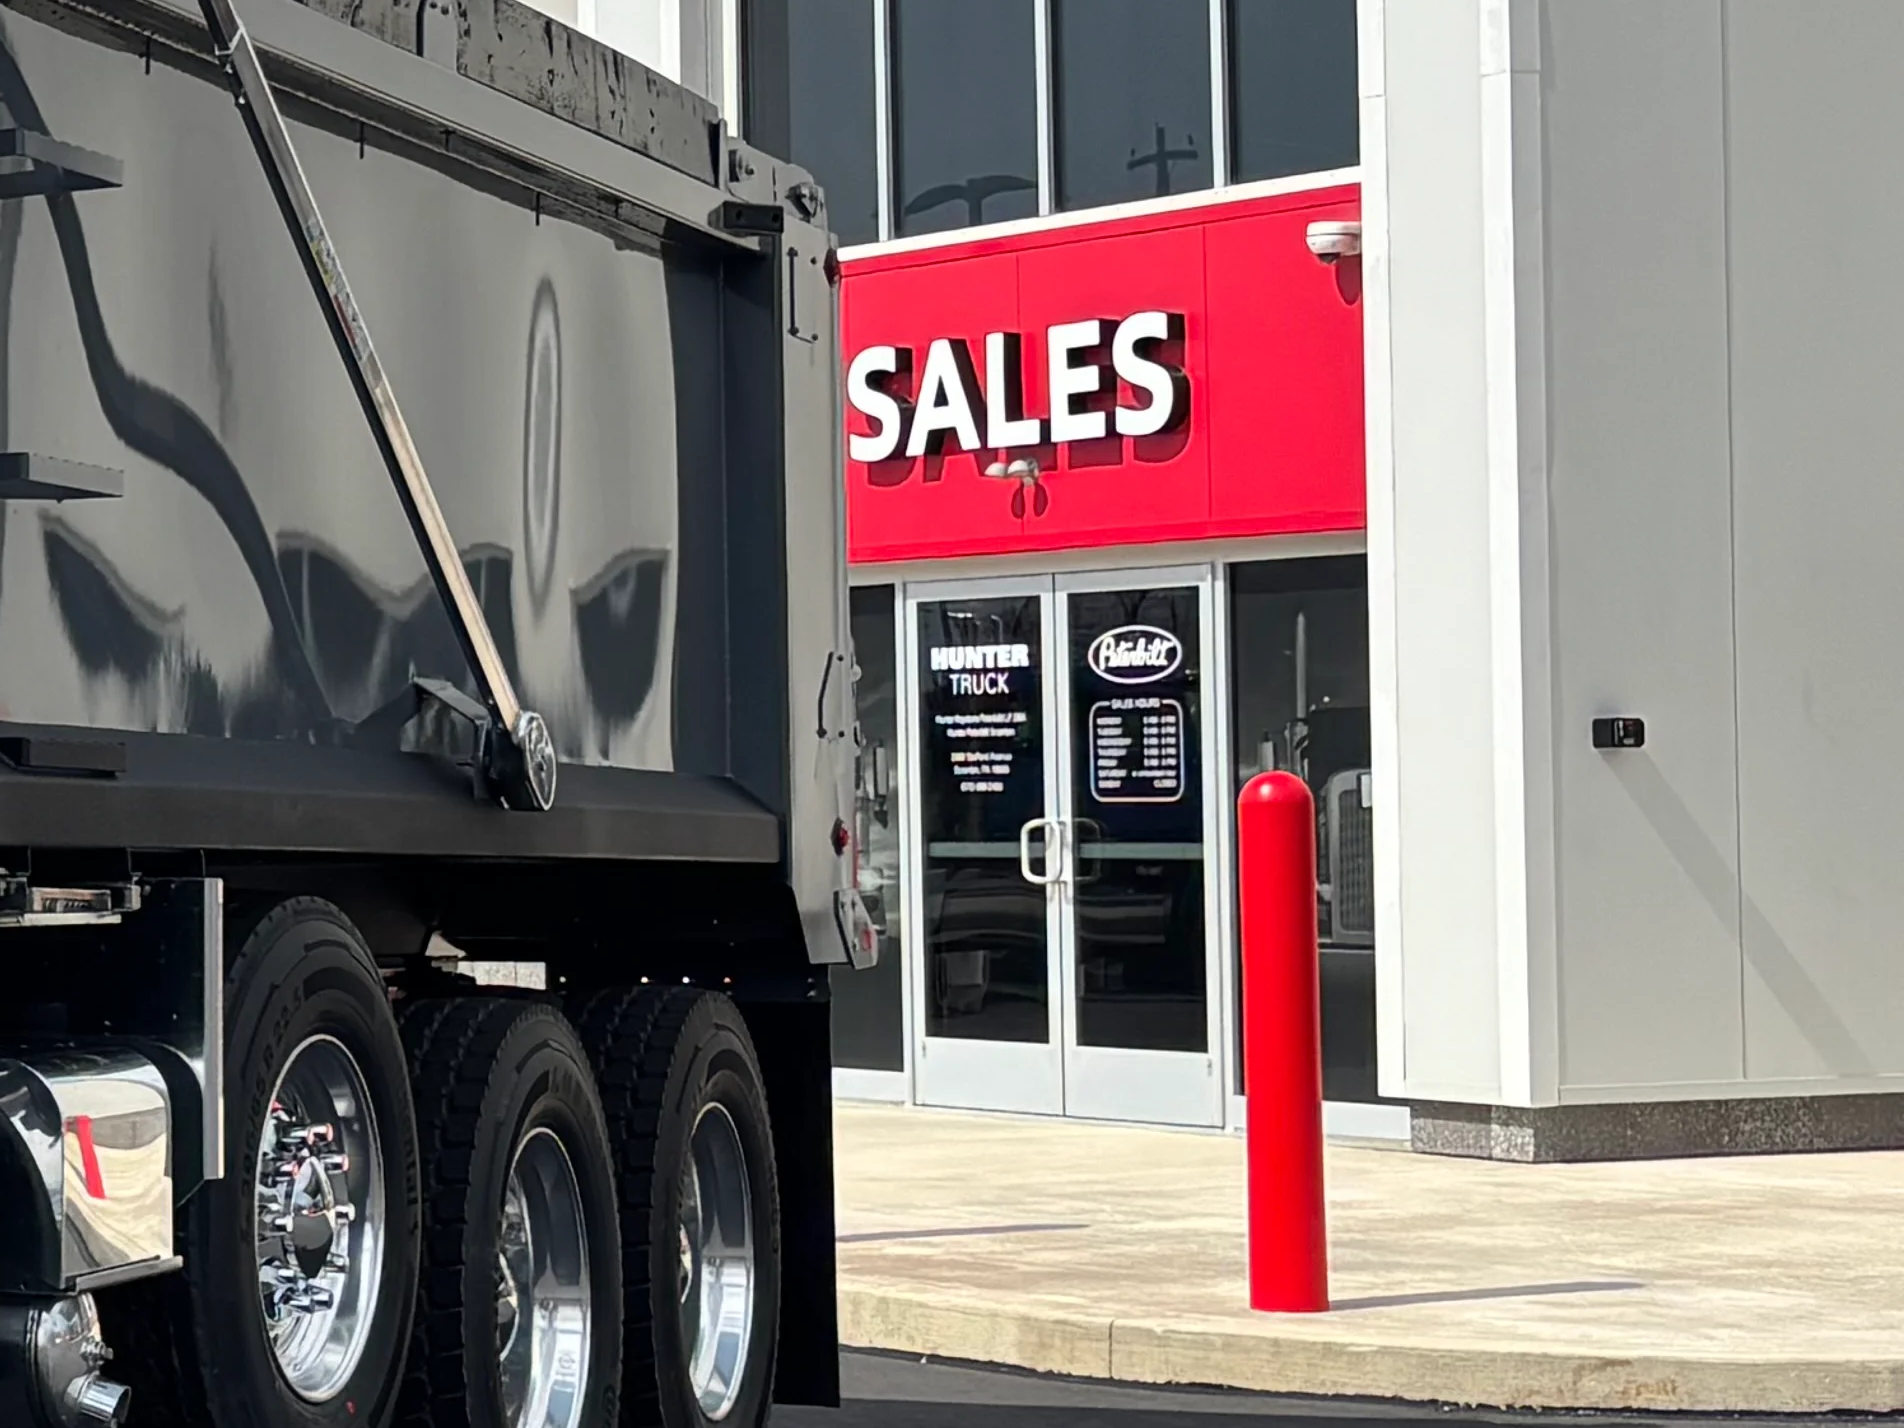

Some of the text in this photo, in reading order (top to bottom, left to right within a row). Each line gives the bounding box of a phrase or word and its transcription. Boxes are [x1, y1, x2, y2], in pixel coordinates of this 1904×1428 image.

[846, 310, 1184, 463] SALES
[930, 643, 1030, 671] HUNTER
[1098, 635, 1175, 671] Peterbilt
[948, 672, 1010, 696] TRUCK
